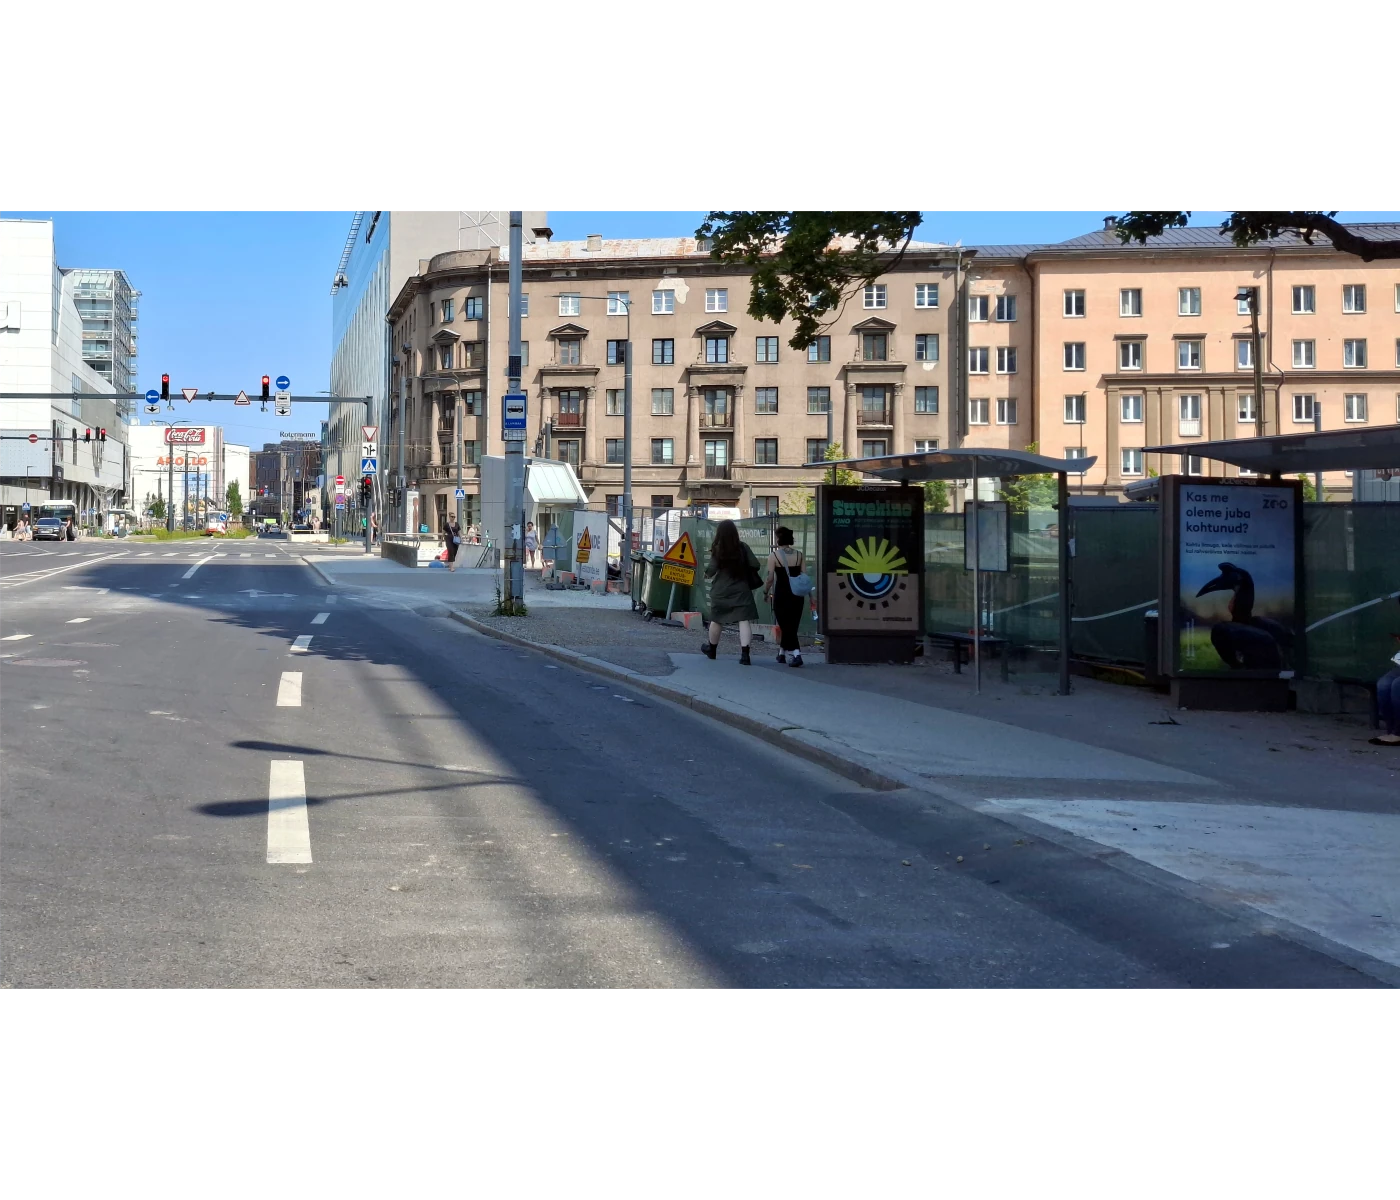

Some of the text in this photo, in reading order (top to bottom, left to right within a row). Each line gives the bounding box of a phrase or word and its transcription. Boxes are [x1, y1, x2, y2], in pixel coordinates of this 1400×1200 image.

[1186, 491, 1229, 503] Kas me
[832, 499, 913, 517] Suvekino
[1186, 506, 1251, 520] oleme juba
[1186, 521, 1249, 534] kohtunud?
